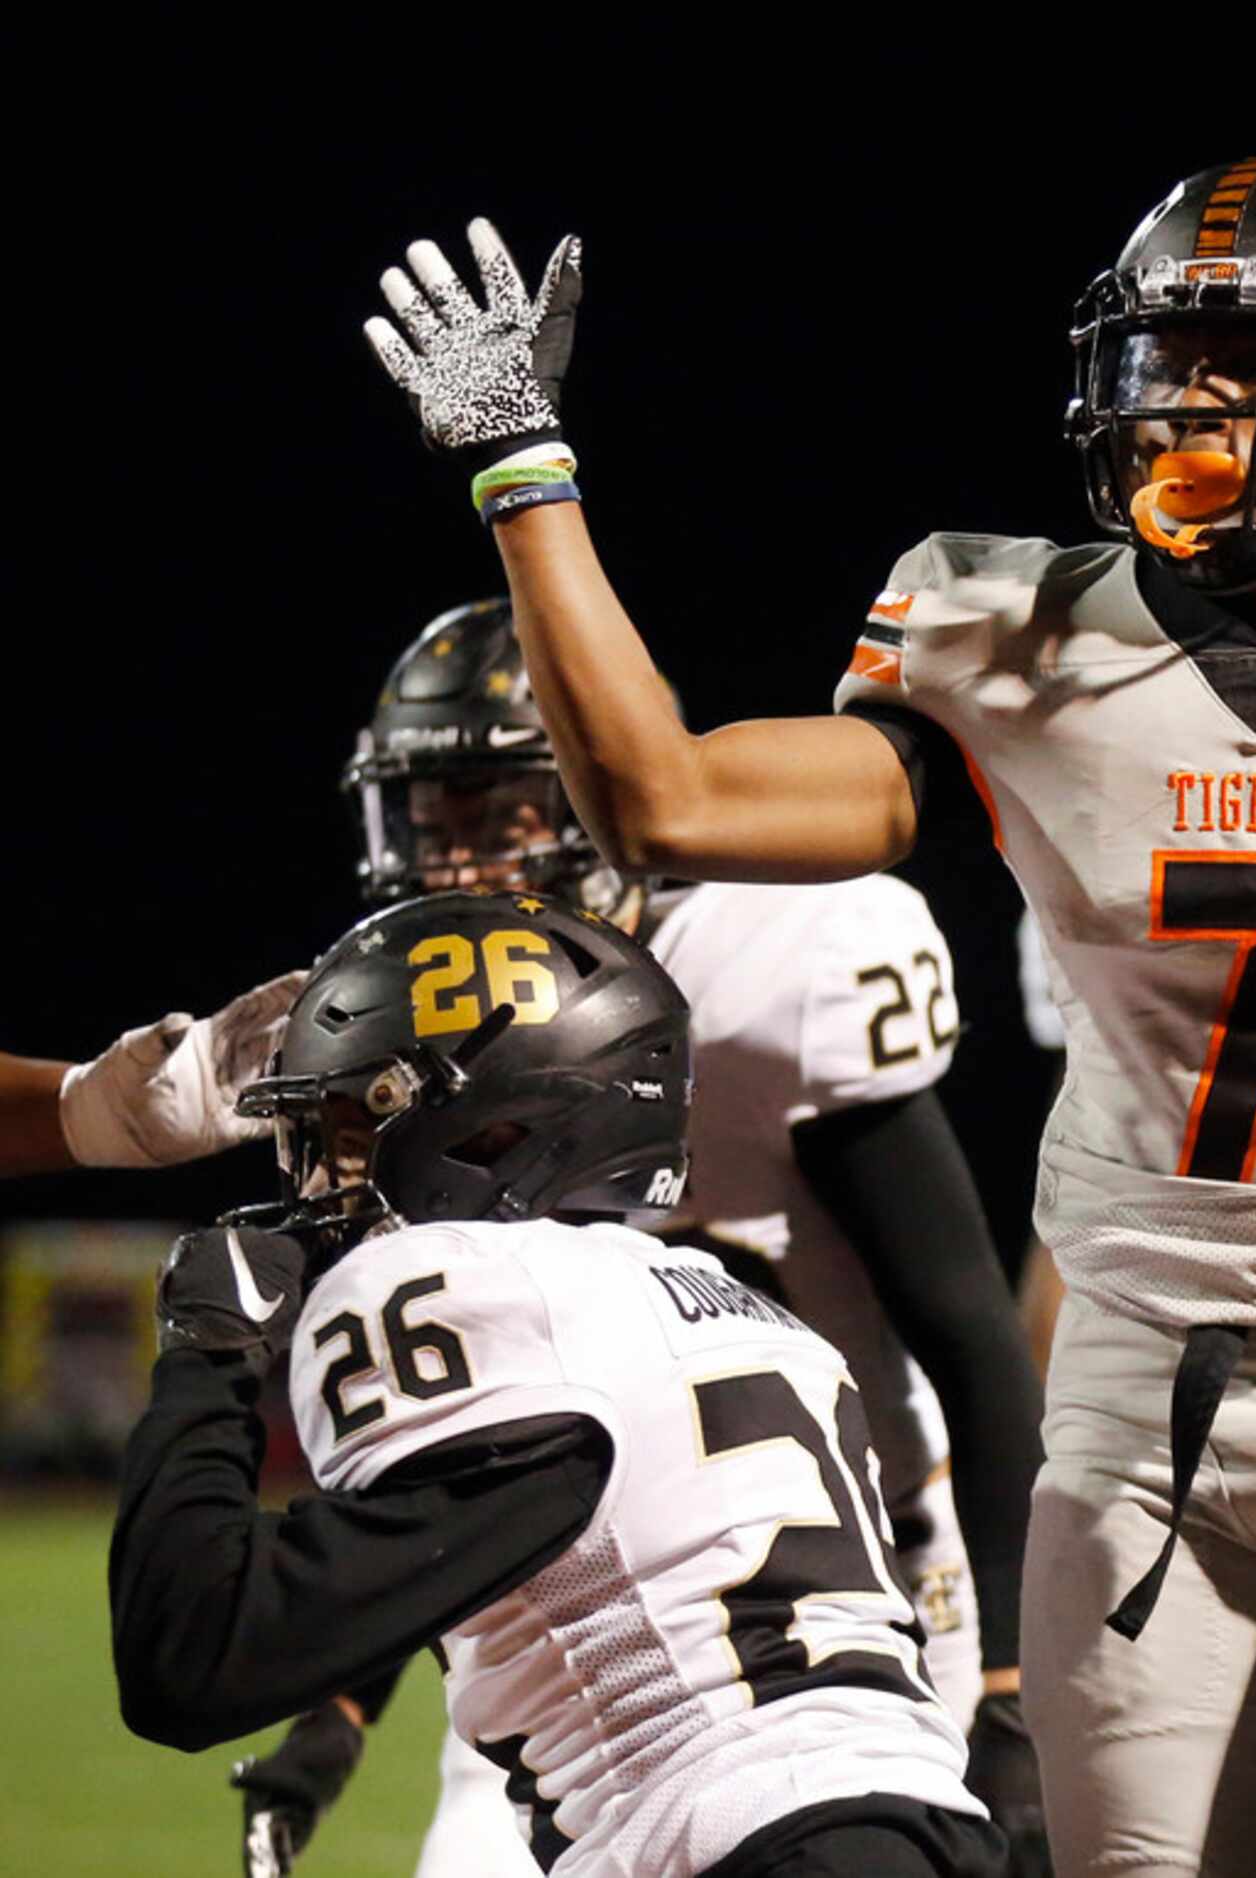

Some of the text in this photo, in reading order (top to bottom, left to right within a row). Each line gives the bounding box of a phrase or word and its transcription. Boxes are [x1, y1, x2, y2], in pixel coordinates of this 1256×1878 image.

[407, 929, 560, 1038] 26
[855, 947, 960, 1068] 22
[311, 1269, 475, 1446] 26
